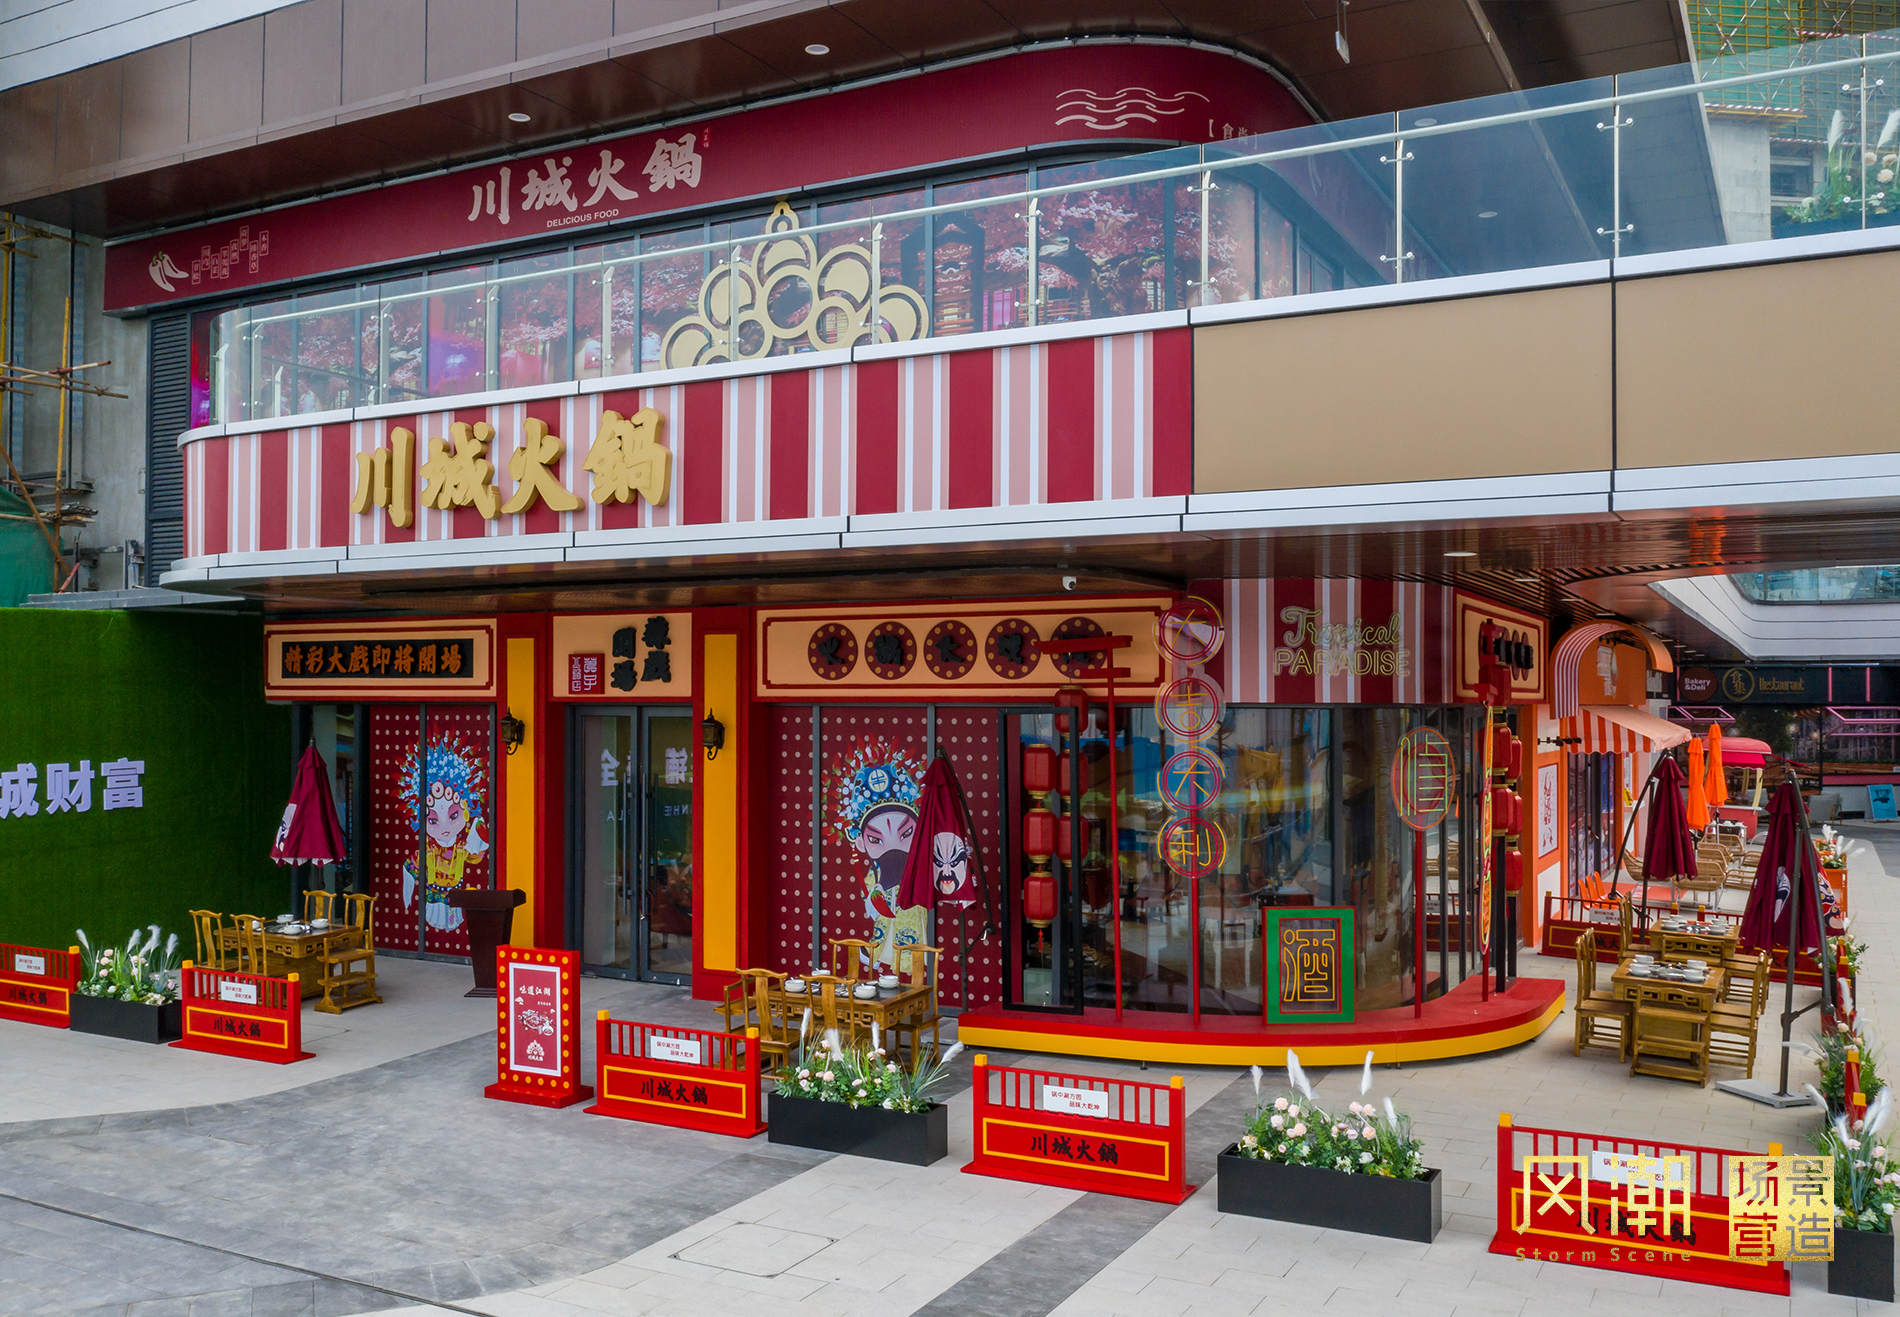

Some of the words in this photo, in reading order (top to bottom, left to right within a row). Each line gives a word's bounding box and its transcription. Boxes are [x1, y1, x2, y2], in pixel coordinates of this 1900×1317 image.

[467, 133, 703, 225] 川城火鍋
[546, 212, 592, 228] DELICIOUS
[594, 208, 620, 220] FOOD
[351, 407, 673, 528] 川城火鍋
[1281, 606, 1403, 655] Tropical
[284, 643, 463, 675] 精彩大戲即將開場
[1273, 648, 1411, 676] PARADISE
[1684, 677, 1711, 687] Bakery
[1759, 677, 1805, 691] Restaurant
[1030, 1132, 1119, 1165] 川城火鍋
